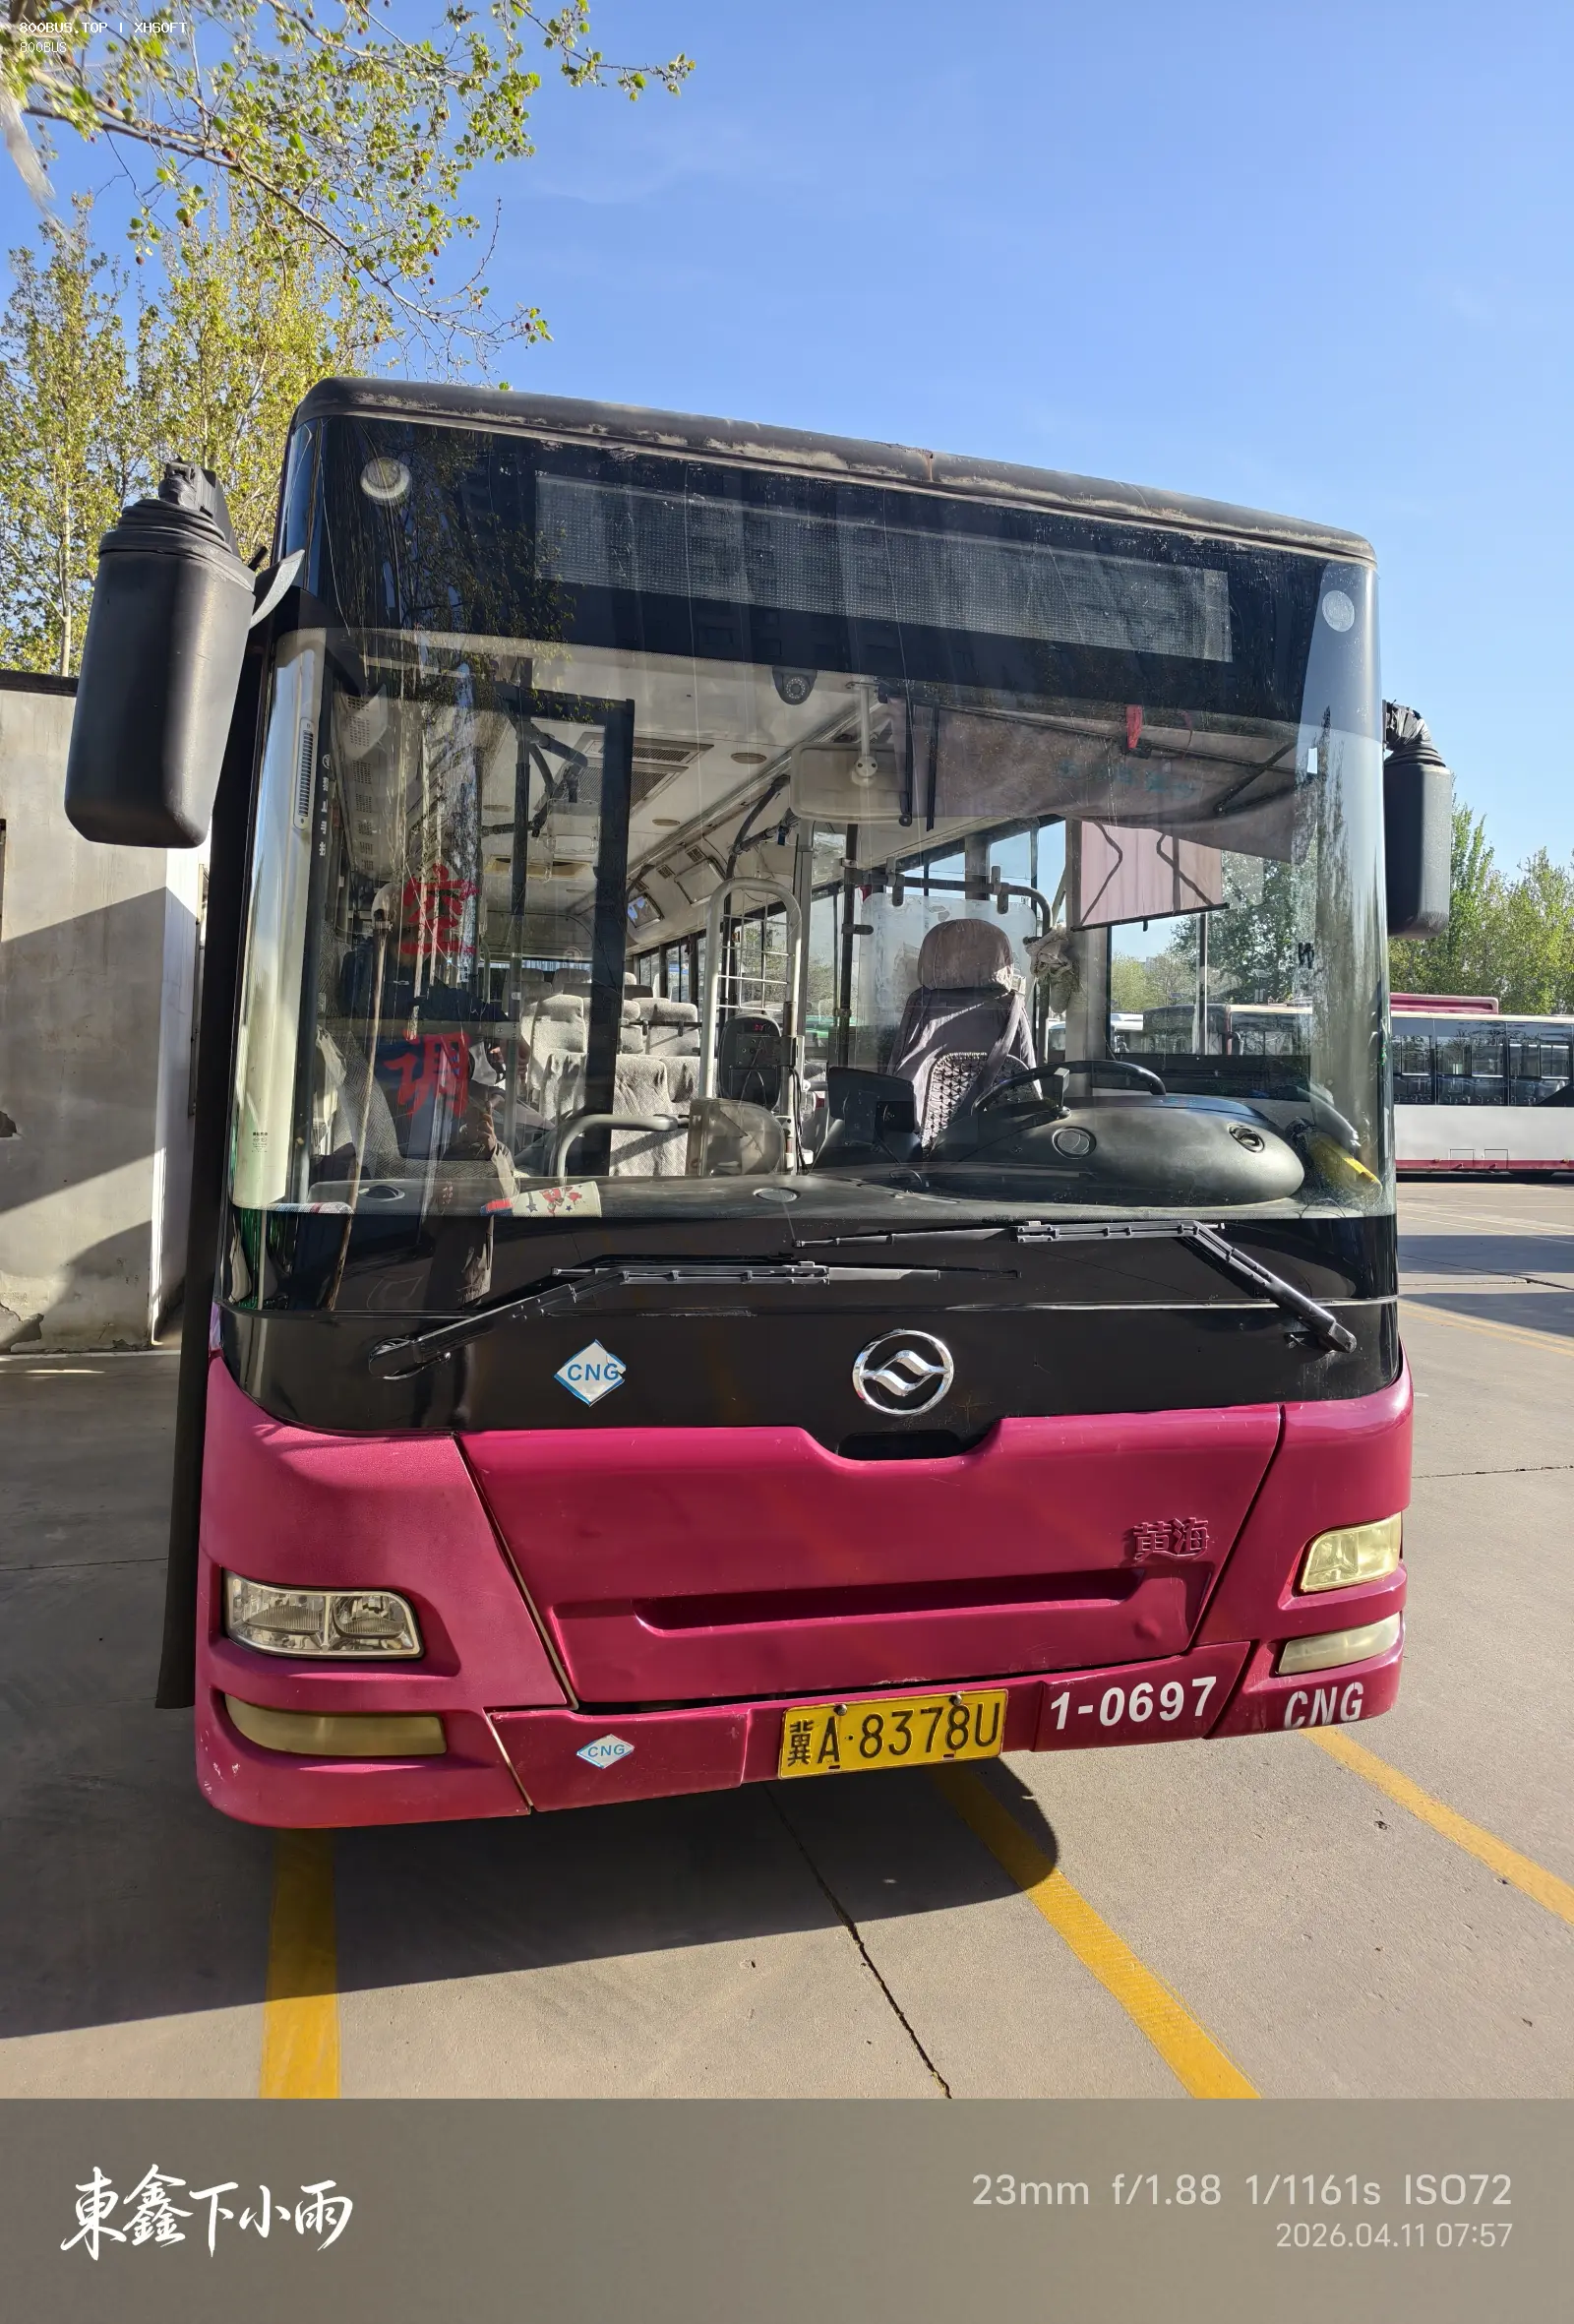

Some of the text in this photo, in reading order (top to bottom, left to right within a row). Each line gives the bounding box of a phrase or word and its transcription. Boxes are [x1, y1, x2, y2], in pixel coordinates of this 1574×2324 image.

[567, 1363, 620, 1381] CNG
[1132, 1517, 1209, 1562] 黄海
[1050, 1676, 1218, 1730] 1-0697
[1284, 1682, 1364, 1730] CNG
[587, 1743, 626, 1758] CNG
